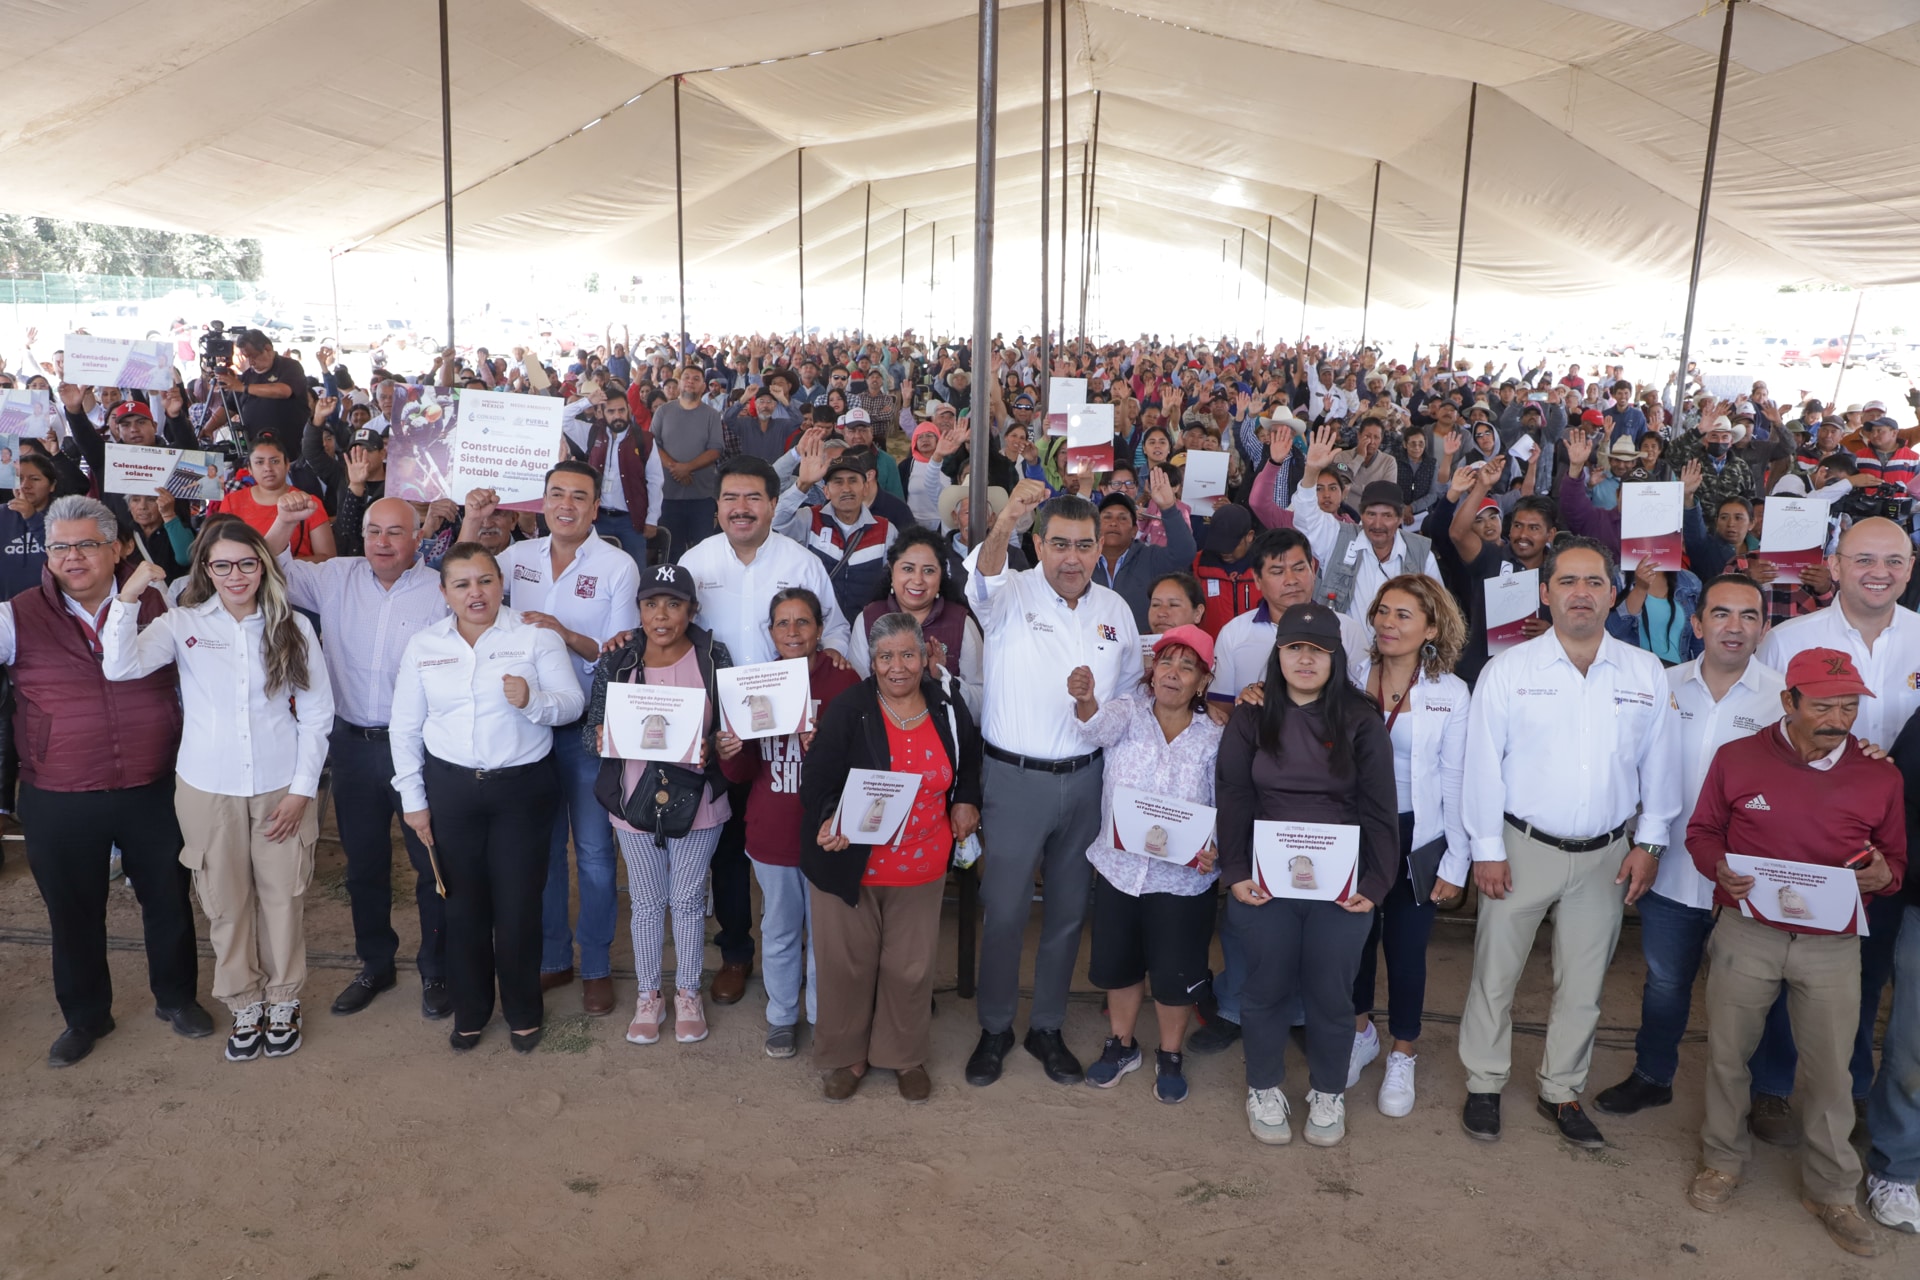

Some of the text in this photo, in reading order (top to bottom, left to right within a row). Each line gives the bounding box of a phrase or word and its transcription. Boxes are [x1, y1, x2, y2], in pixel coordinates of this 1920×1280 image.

[71, 353, 119, 362] Calentadores
[461, 441, 550, 457] Construcción del
[113, 462, 165, 471] Calentadores
[460, 454, 548, 471] Sistema de Agua
[459, 466, 499, 478] Potable
[5, 543, 46, 554] adid
[760, 733, 801, 762] HEA
[771, 761, 802, 793] SH
[1142, 806, 1181, 818] Fortalecimiento
[1765, 872, 1814, 883] Fortalecimiento
